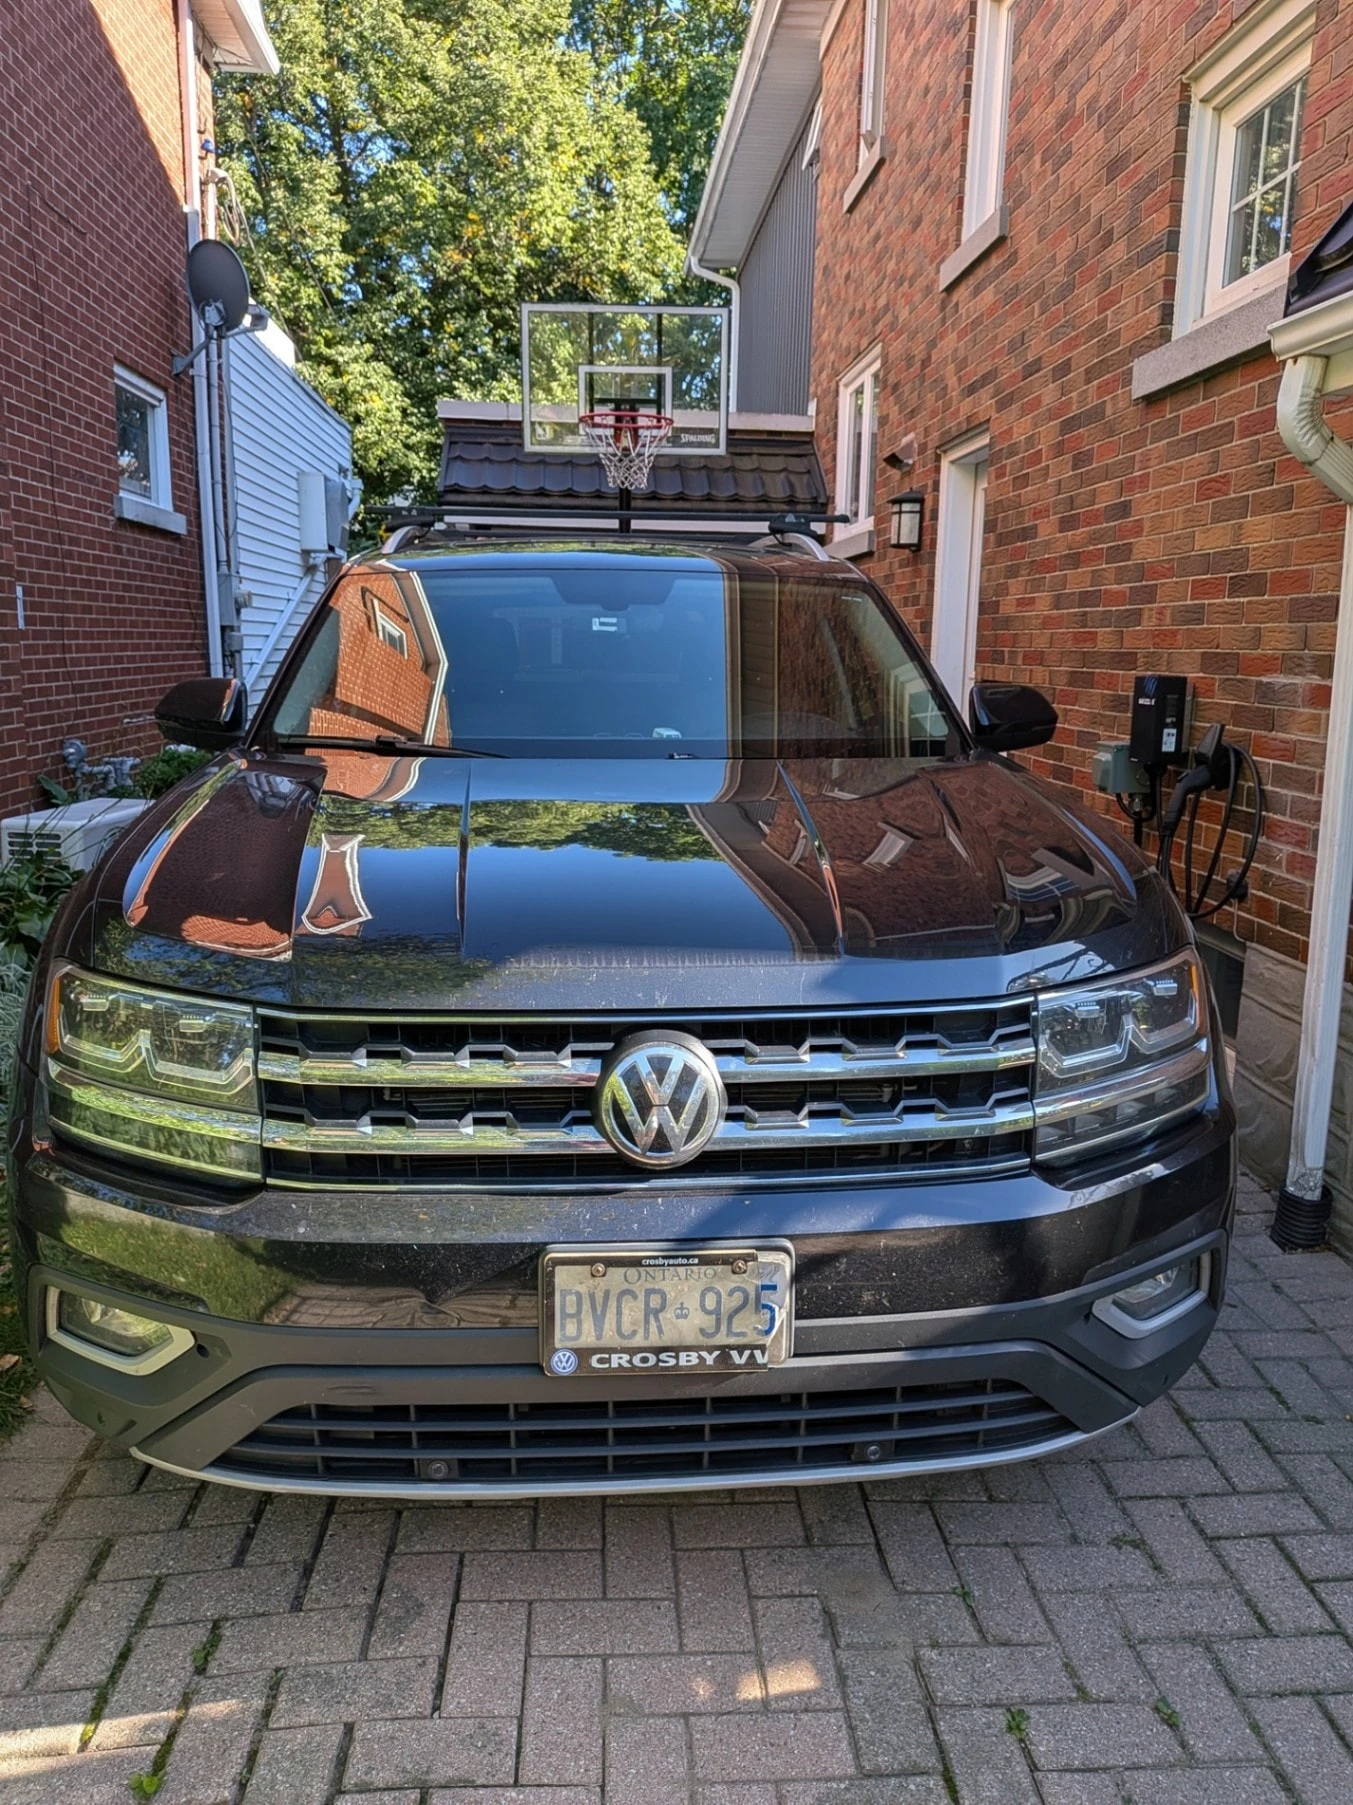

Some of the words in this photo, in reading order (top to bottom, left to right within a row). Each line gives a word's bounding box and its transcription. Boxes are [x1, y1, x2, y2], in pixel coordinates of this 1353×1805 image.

[680, 433, 716, 443] SPALDING
[641, 1257, 699, 1266] crosbyauto.ca
[559, 1288, 668, 1342] BVCR
[699, 1285, 777, 1338] 925
[591, 1350, 721, 1369] CROSBY
